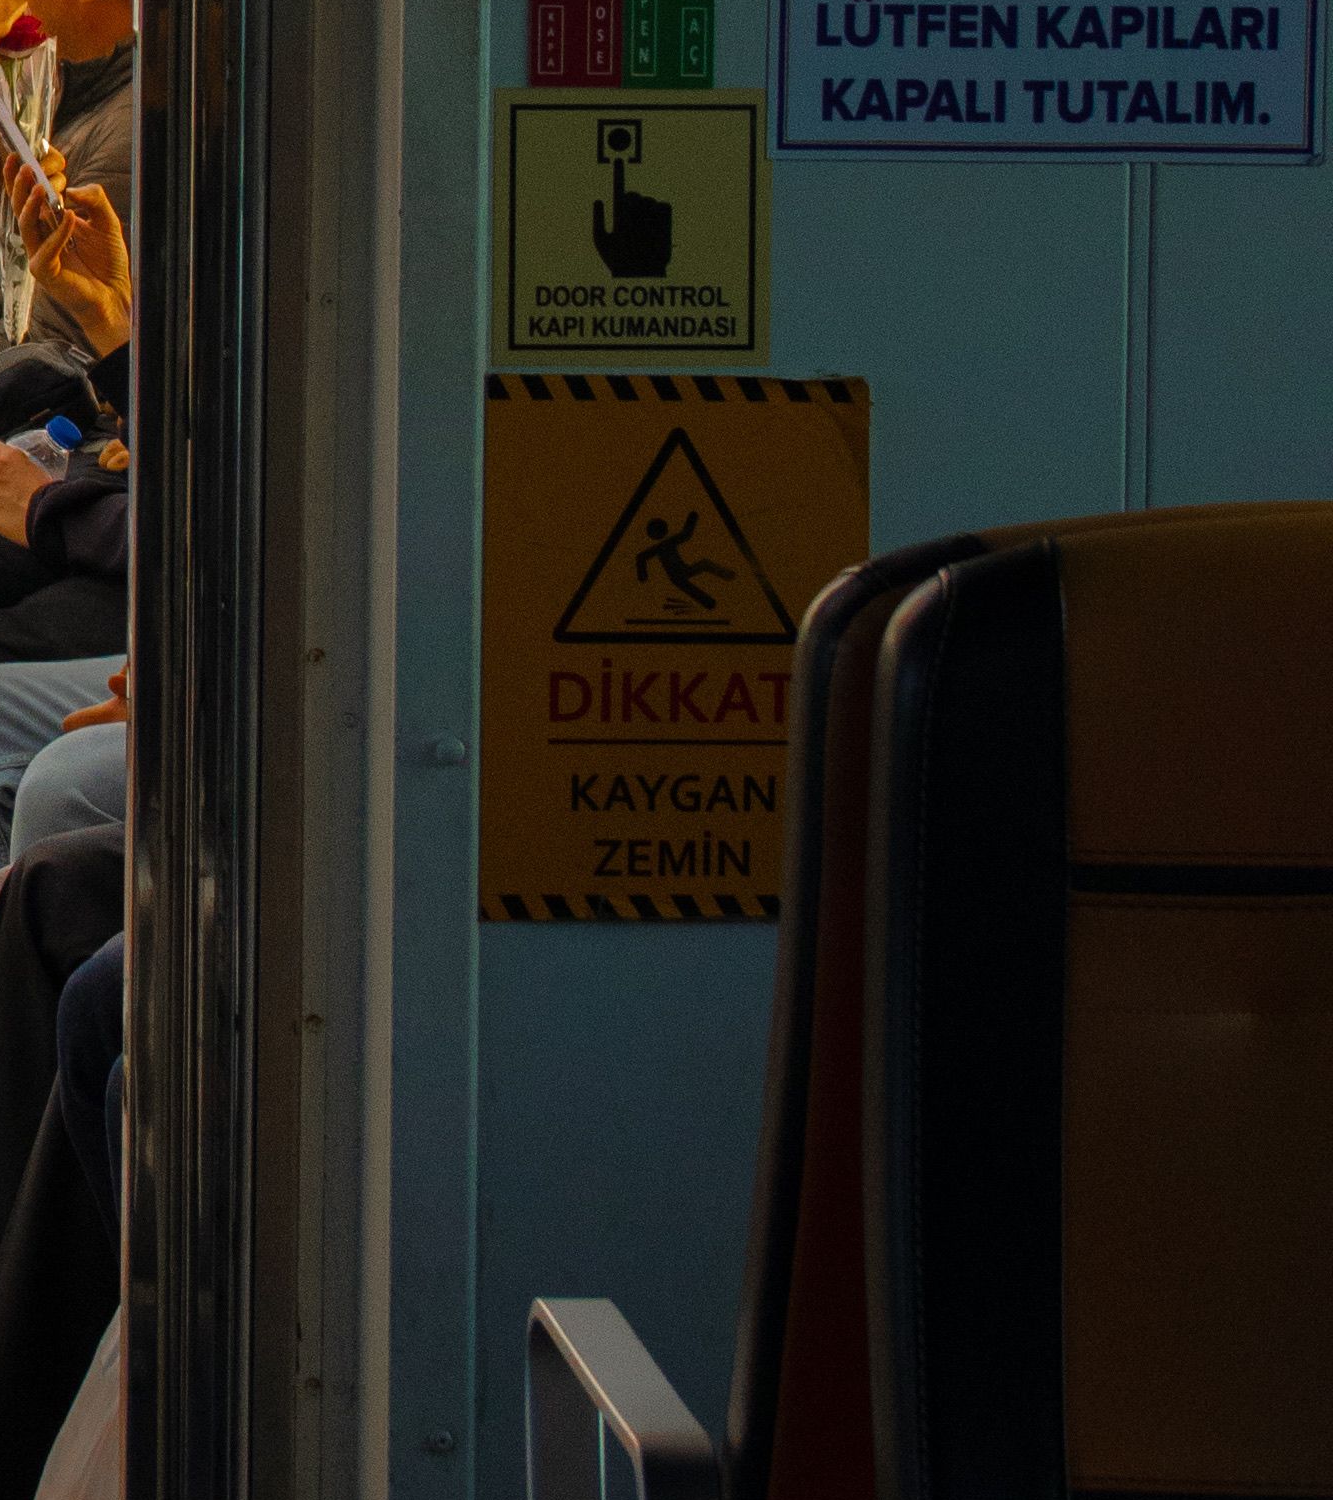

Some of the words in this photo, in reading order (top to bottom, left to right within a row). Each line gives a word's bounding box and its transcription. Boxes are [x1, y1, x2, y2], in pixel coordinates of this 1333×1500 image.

[547, 13, 555, 67] KAPA
[689, 19, 700, 66] AÇ
[1036, 5, 1279, 53] KAPILARI
[822, 79, 1007, 123] KAPALI
[1024, 81, 1270, 126] TUTALIM.
[535, 285, 607, 308] DOOR
[614, 287, 728, 309] CONTROL
[529, 315, 586, 336] KAPI
[593, 315, 736, 338] KUMANDASI
[549, 658, 789, 724] DİKKAT
[572, 773, 775, 812] KAYGAN
[594, 831, 751, 878] ZEMİN
